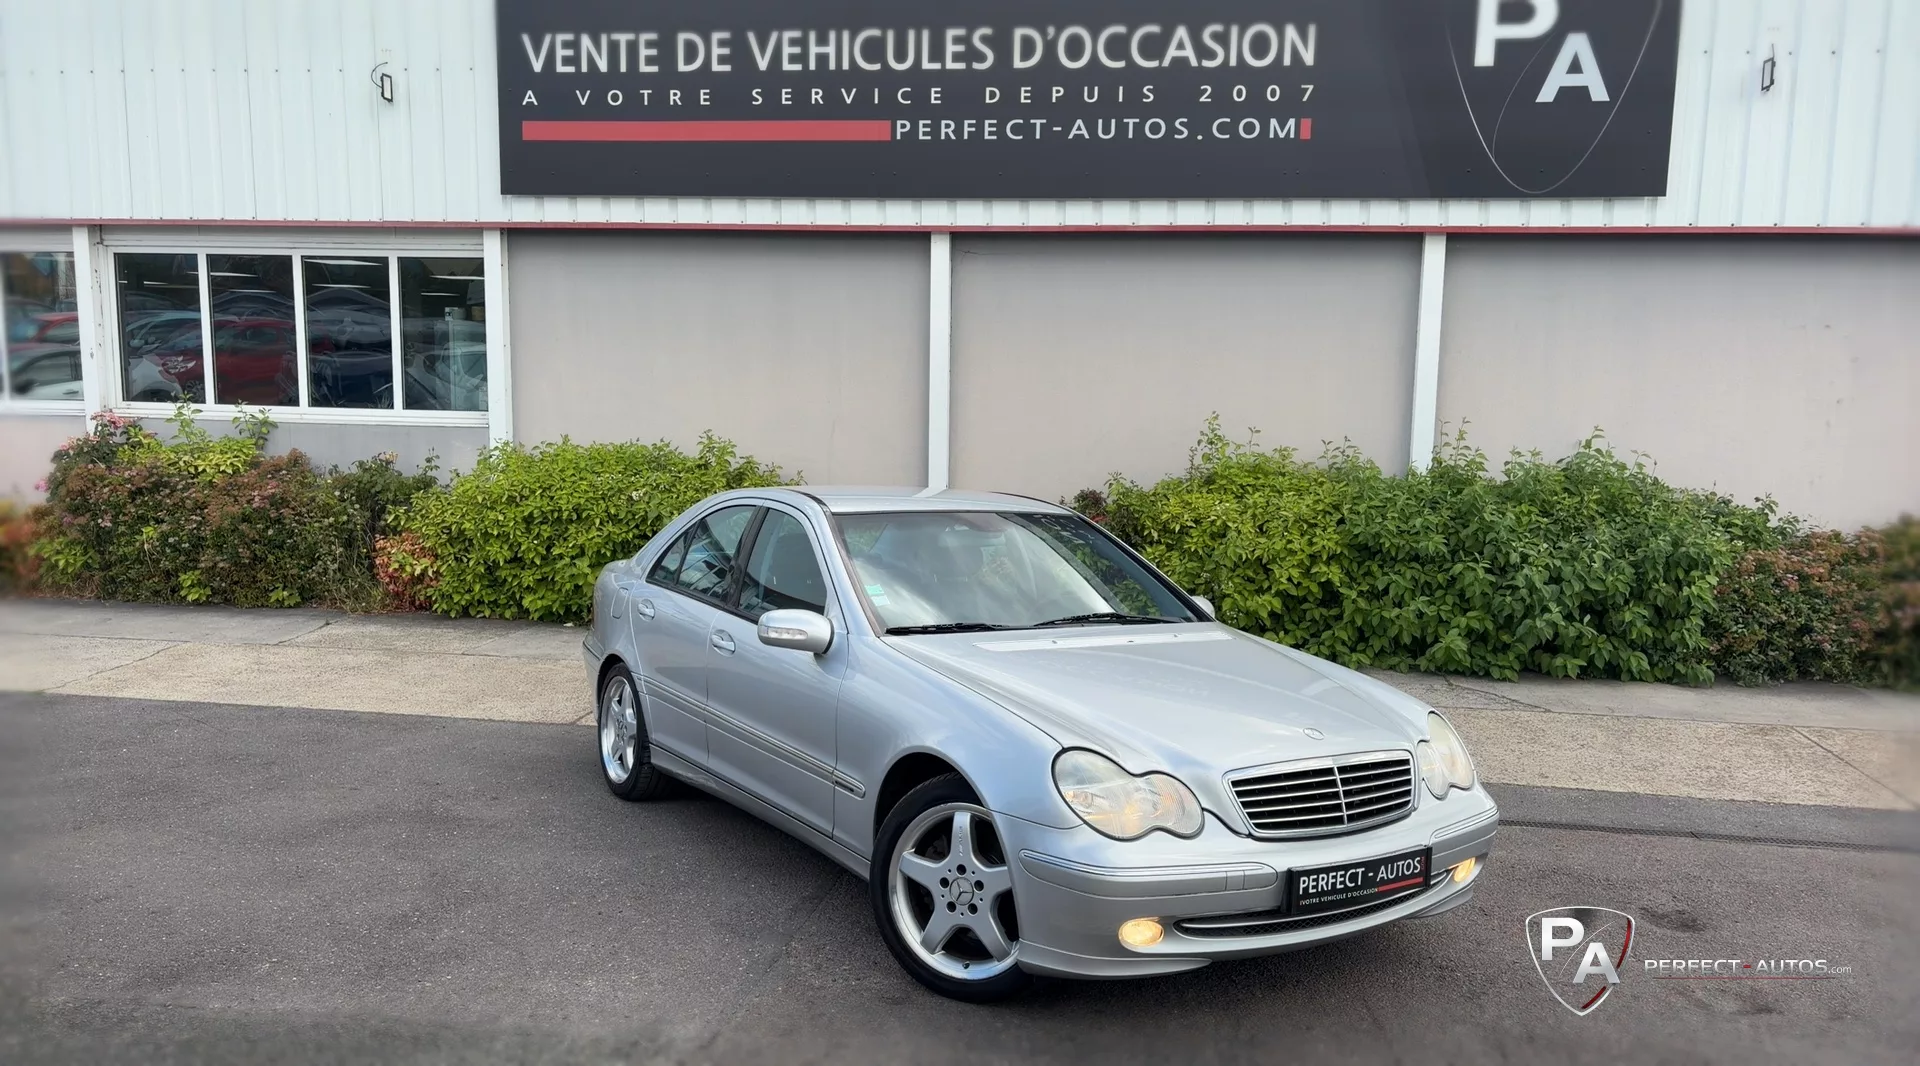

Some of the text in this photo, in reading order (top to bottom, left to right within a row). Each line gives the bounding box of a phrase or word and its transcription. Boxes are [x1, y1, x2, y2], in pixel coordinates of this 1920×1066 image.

[521, 23, 1317, 73] VENTE DE VEHICULES D'OCCASION
[1474, 0, 1560, 67] P
[1535, 31, 1610, 103] A
[522, 84, 1315, 106] A VOTRE SERVICE DEPUIS 2007
[896, 117, 1297, 141] PERFECT-AUTOS.COM
[1299, 868, 1365, 895] PERFECT
[1377, 857, 1420, 881] AUTOS
[1320, 893, 1347, 902] VEHICULE
